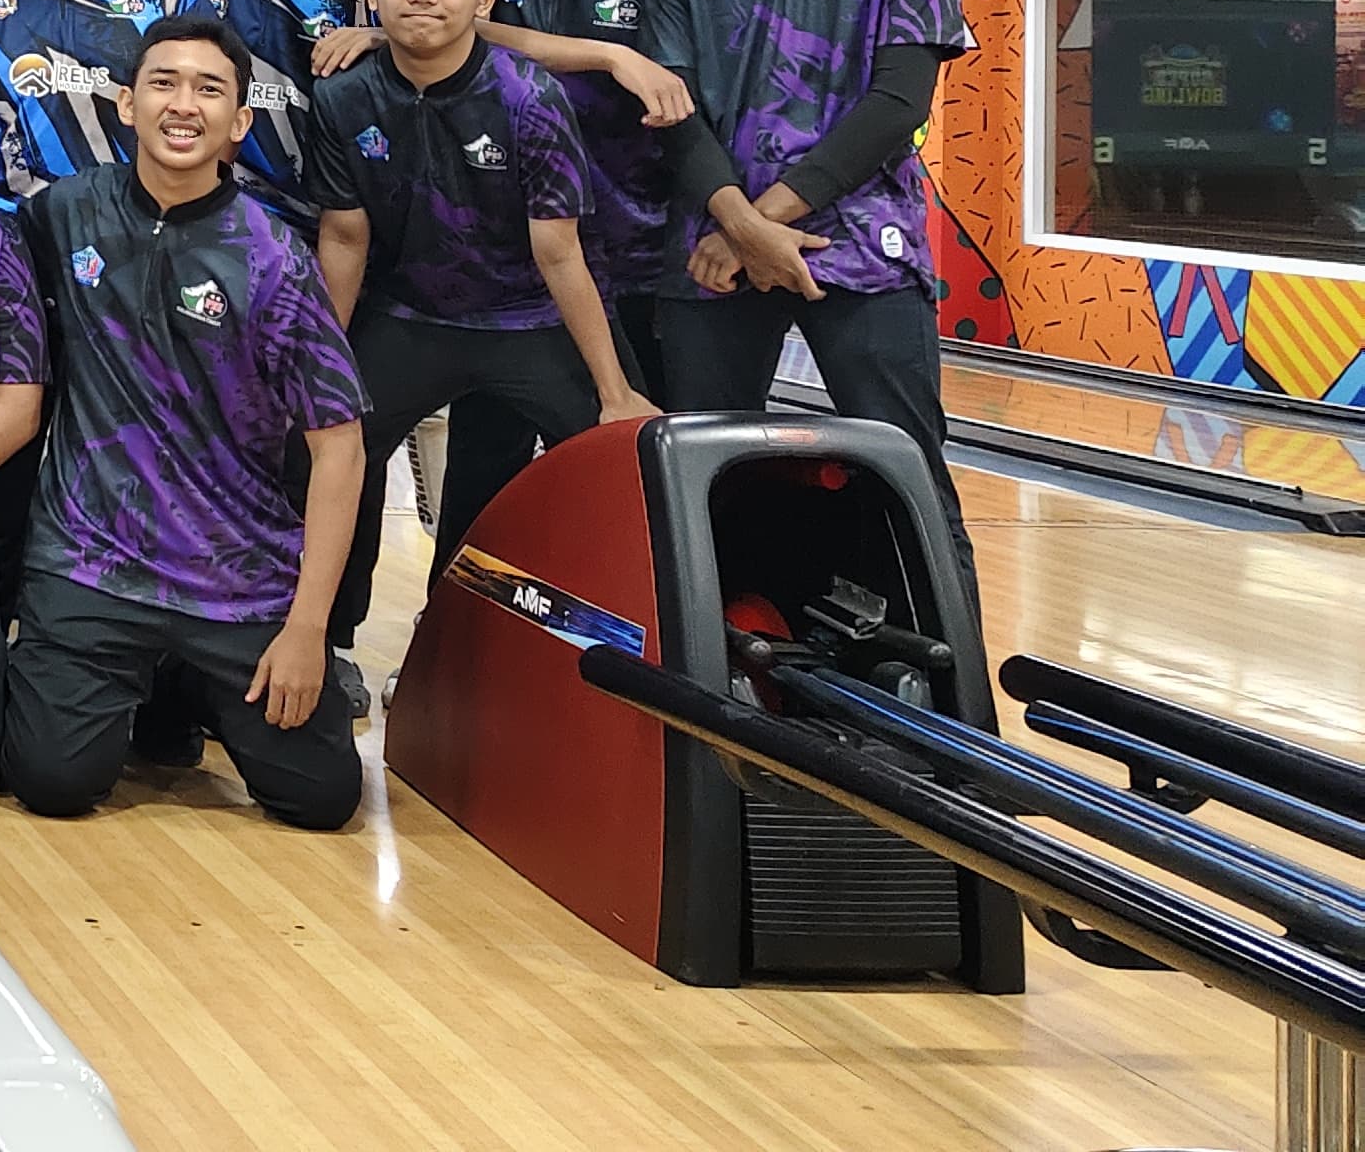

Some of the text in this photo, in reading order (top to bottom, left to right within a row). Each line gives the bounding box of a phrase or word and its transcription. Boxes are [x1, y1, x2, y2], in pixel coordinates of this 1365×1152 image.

[58, 65, 109, 85] REL'S
[58, 82, 92, 92] HOUSE
[251, 99, 286, 110] HOUSE
[512, 585, 552, 618] AMF
